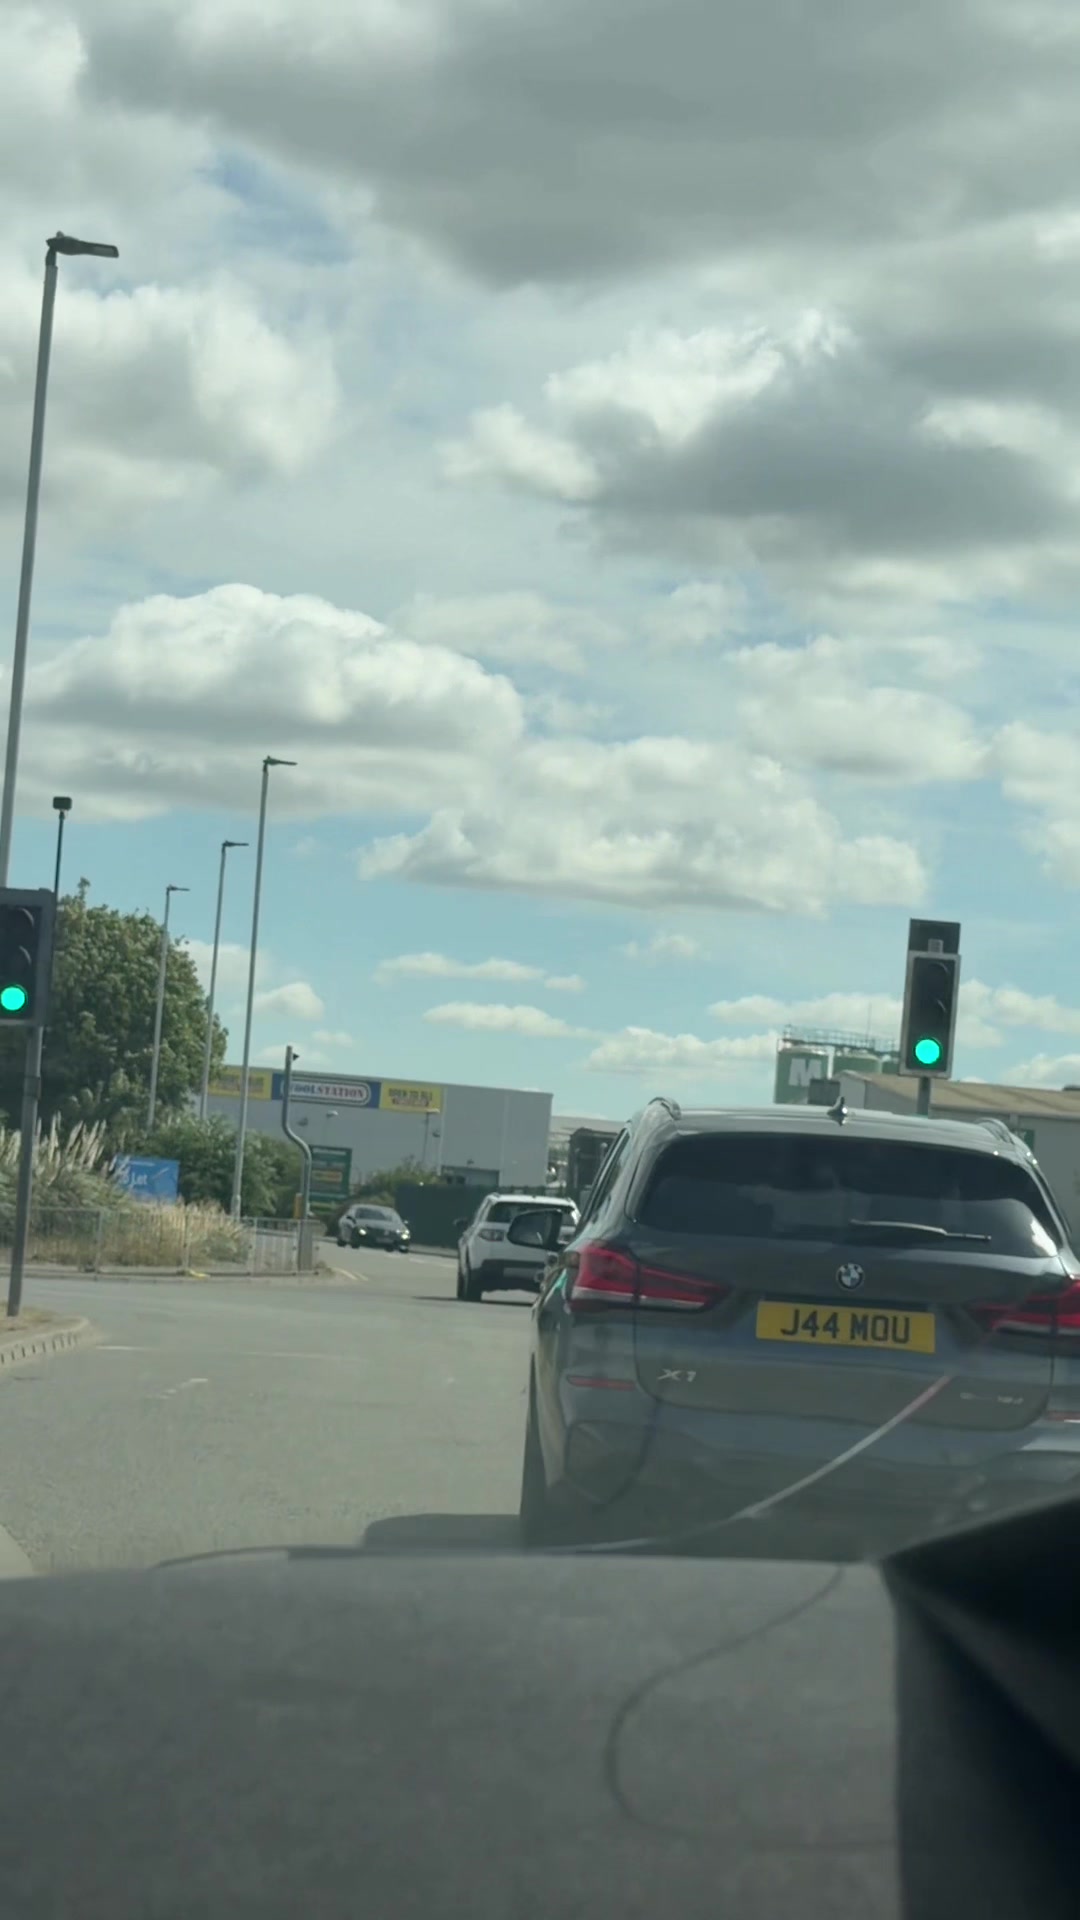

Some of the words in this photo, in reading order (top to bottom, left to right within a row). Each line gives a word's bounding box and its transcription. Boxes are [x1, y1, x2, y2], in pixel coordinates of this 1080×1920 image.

[788, 1058, 821, 1087] M
[780, 1309, 840, 1339] J44
[850, 1313, 910, 1344] MOU
[657, 1368, 697, 1383] X1
